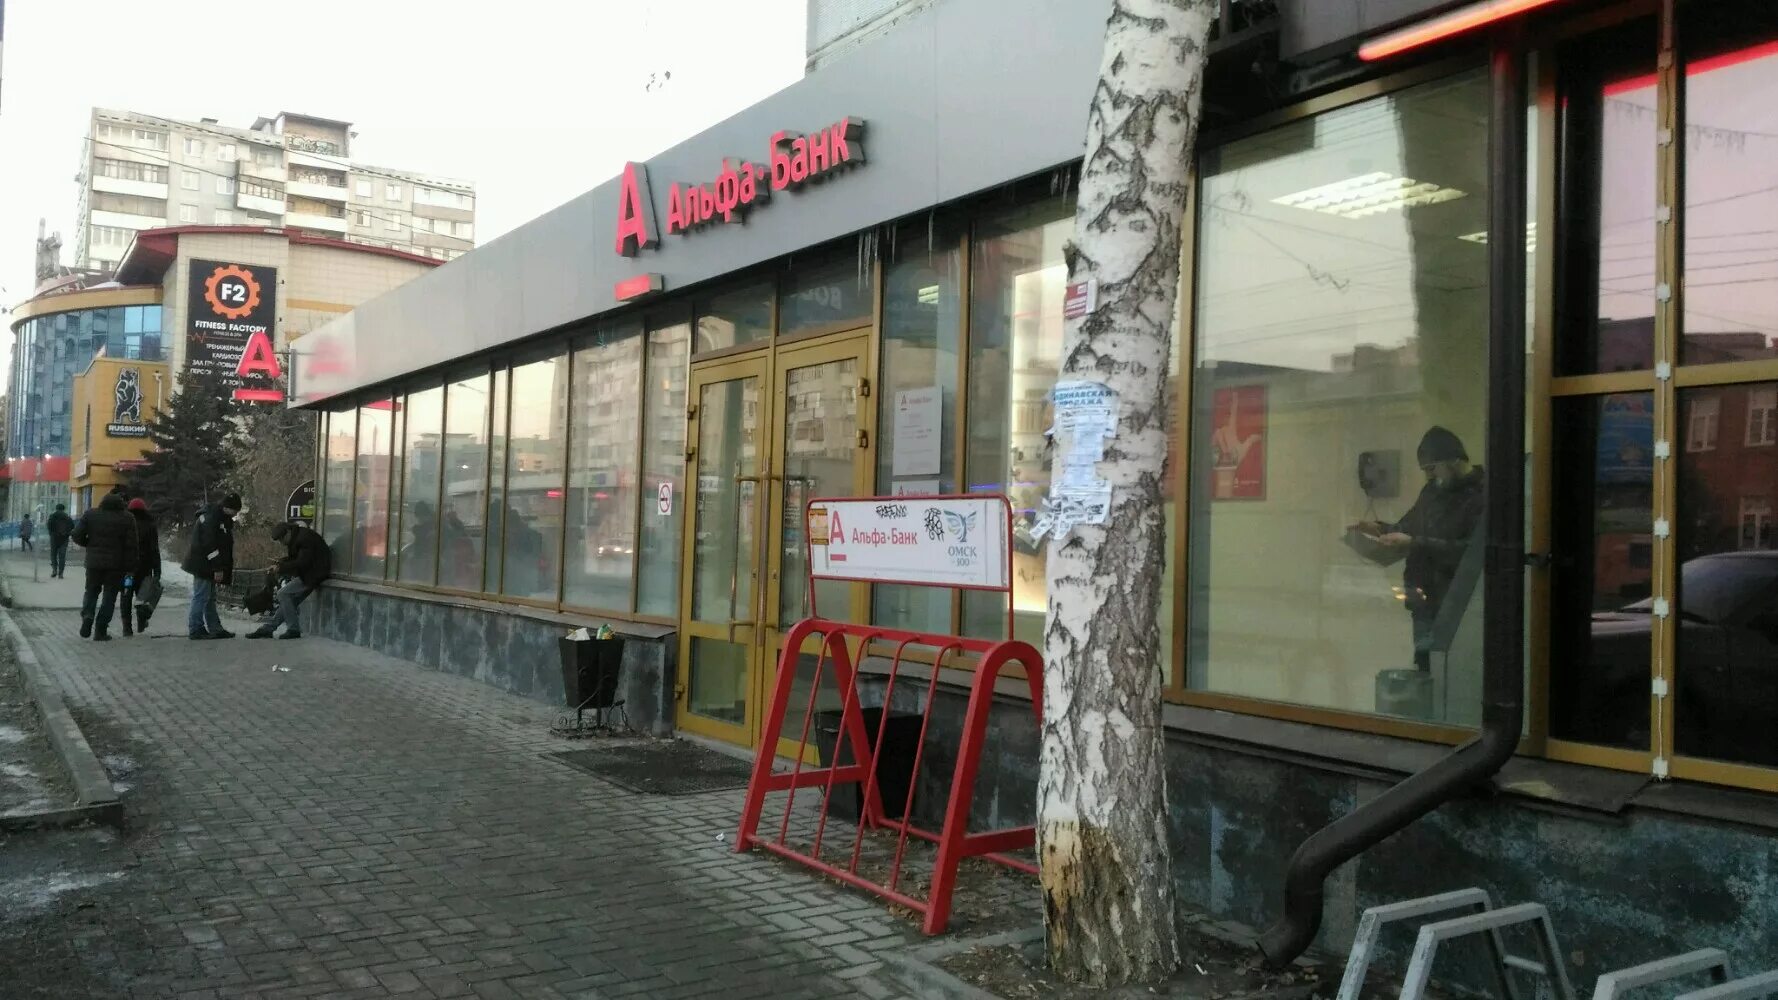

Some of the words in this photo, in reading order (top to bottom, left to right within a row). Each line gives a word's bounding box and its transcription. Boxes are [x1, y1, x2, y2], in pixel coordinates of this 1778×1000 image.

[221, 283, 245, 302] F2
[195, 320, 226, 330] FITNESS
[947, 546, 977, 558] ОМСК
